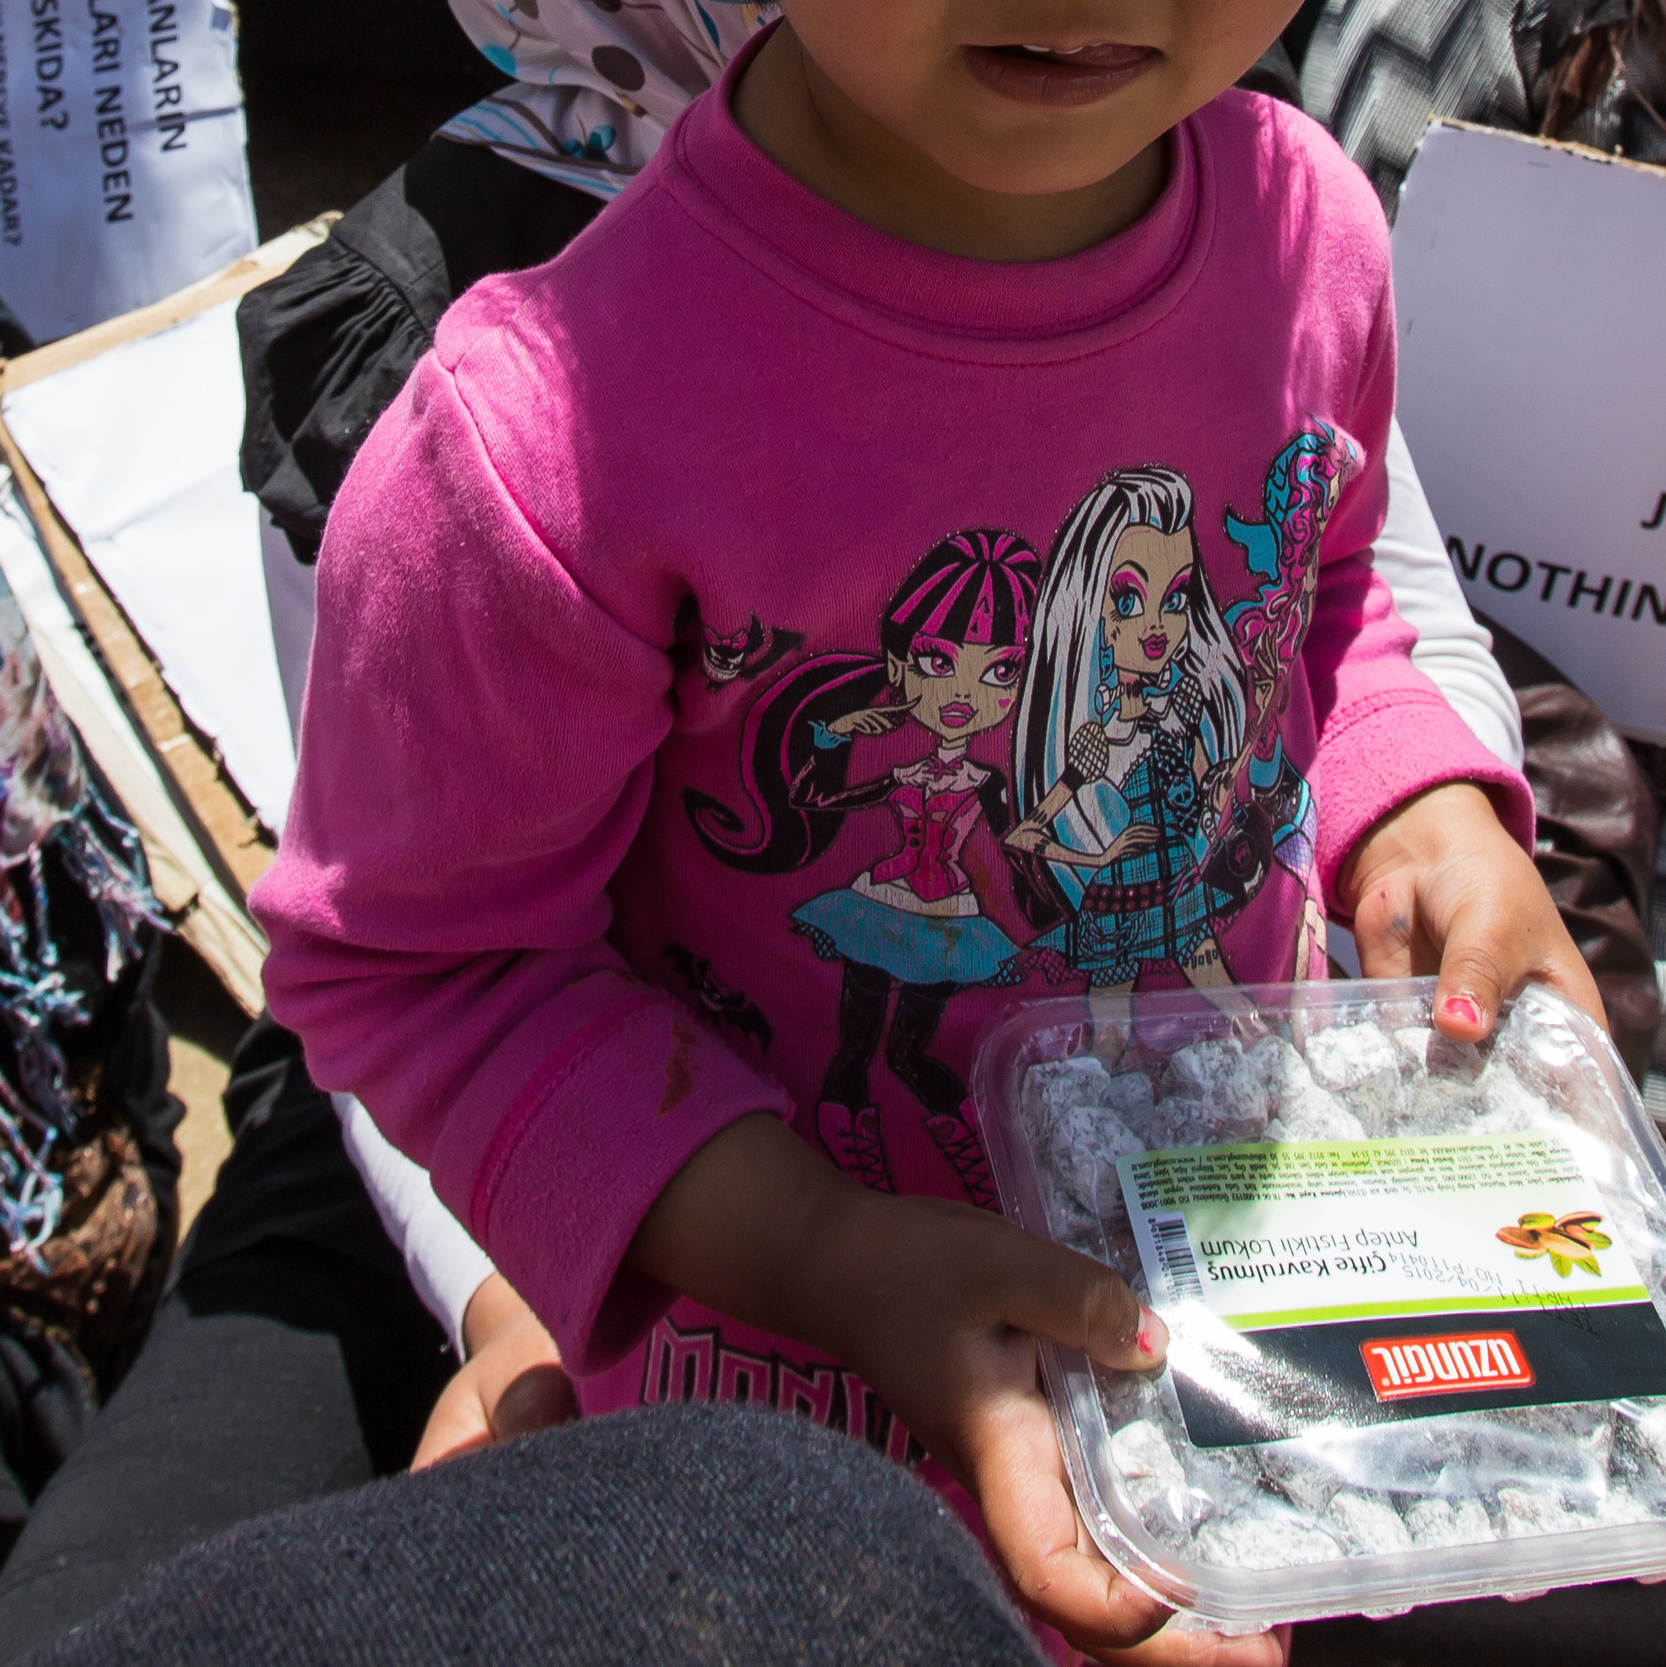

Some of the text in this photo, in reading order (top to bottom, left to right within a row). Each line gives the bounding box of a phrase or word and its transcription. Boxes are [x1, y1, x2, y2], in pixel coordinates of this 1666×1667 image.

[93, 88, 134, 223] NEDEN
[1200, 1229, 1417, 1260] Antep Fıstıklı Lokum
[1207, 1250, 1387, 1283] Çifte Kavrulmuş
